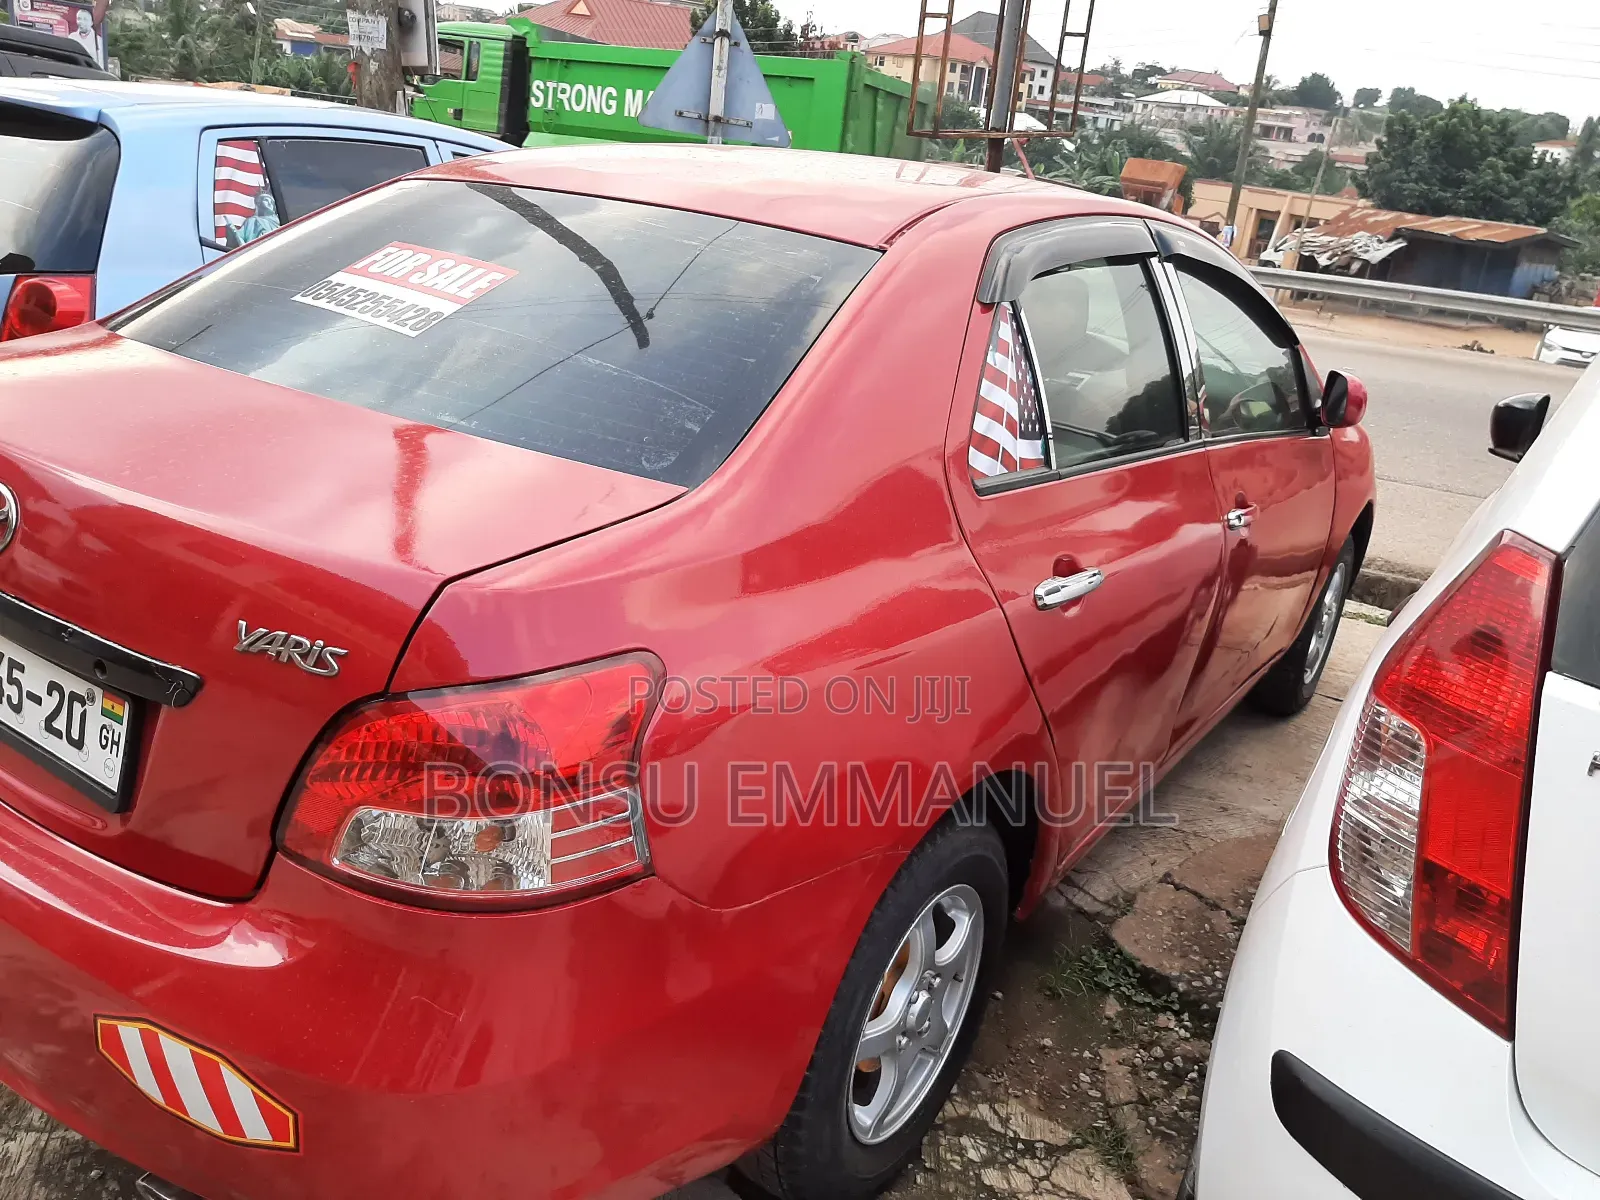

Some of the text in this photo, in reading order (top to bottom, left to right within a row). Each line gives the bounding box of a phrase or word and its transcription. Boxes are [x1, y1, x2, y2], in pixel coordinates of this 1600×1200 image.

[530, 80, 655, 118] STRONG M
[352, 246, 506, 300] FOR SALE
[299, 279, 445, 332] 0545255428
[99, 723, 122, 758] GH
